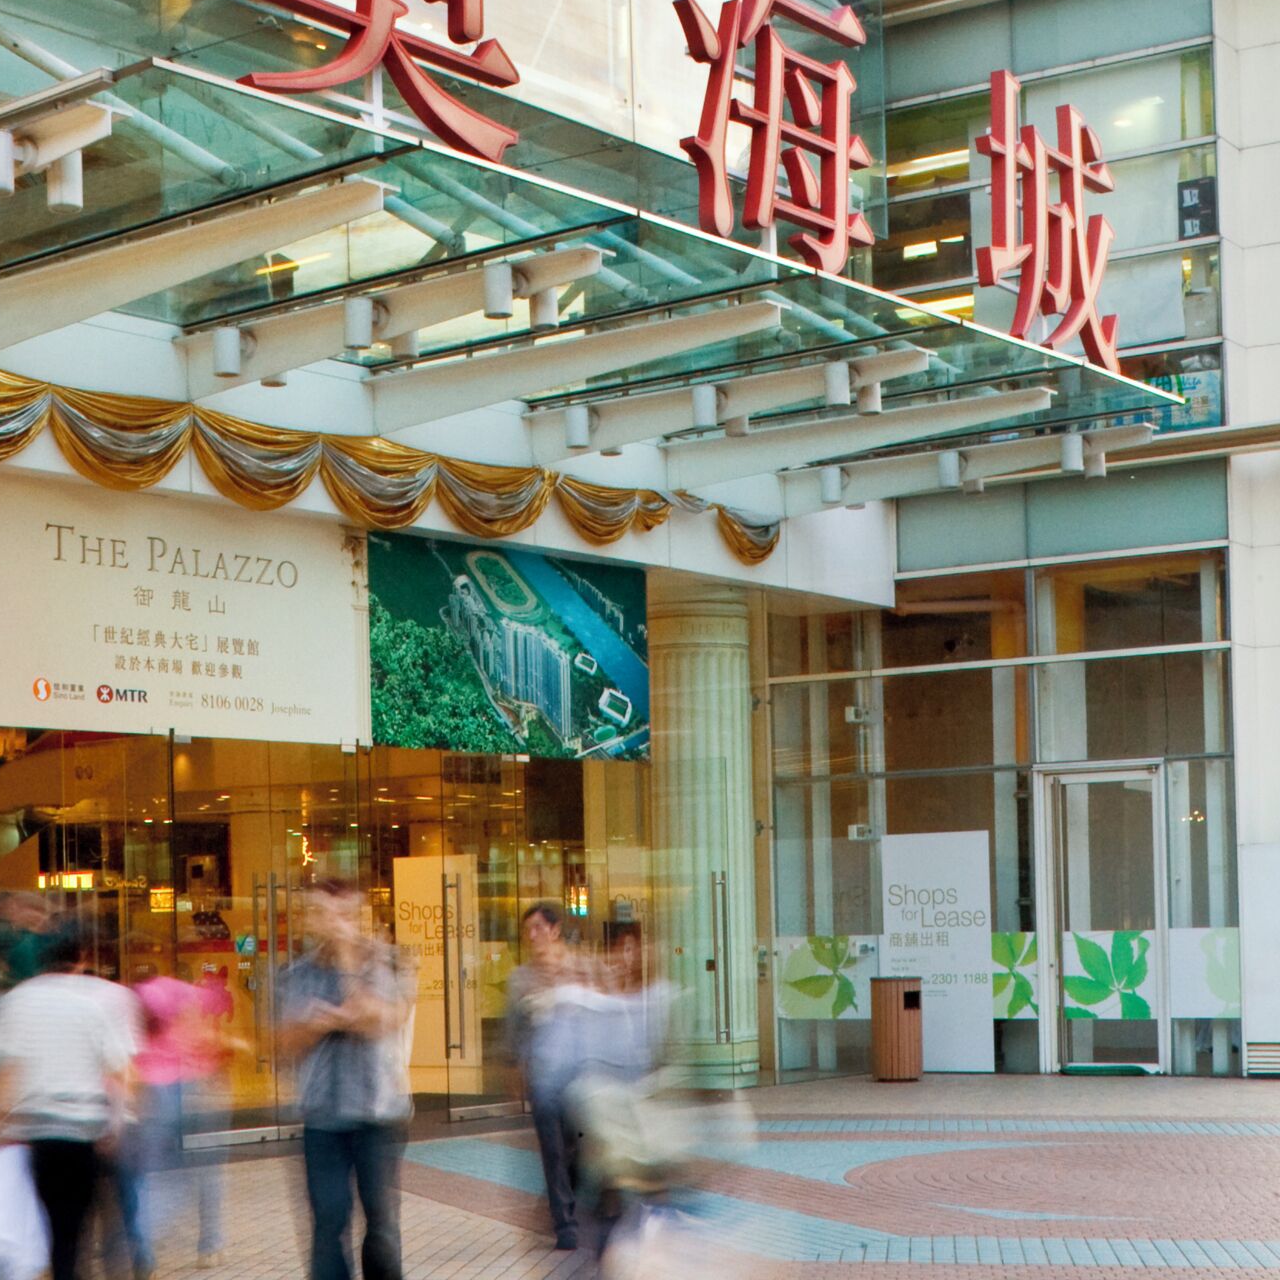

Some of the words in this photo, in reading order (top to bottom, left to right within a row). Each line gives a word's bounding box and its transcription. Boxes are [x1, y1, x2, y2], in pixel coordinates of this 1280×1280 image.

[133, 585, 226, 615] 御龍山
[115, 688, 148, 704] MTR
[200, 694, 232, 711] 8106
[234, 696, 264, 713] 0028
[271, 702, 312, 717] Josephine
[888, 883, 958, 910] Shops
[901, 908, 918, 922] for
[921, 906, 986, 928] Lease
[931, 973, 958, 985] 2301
